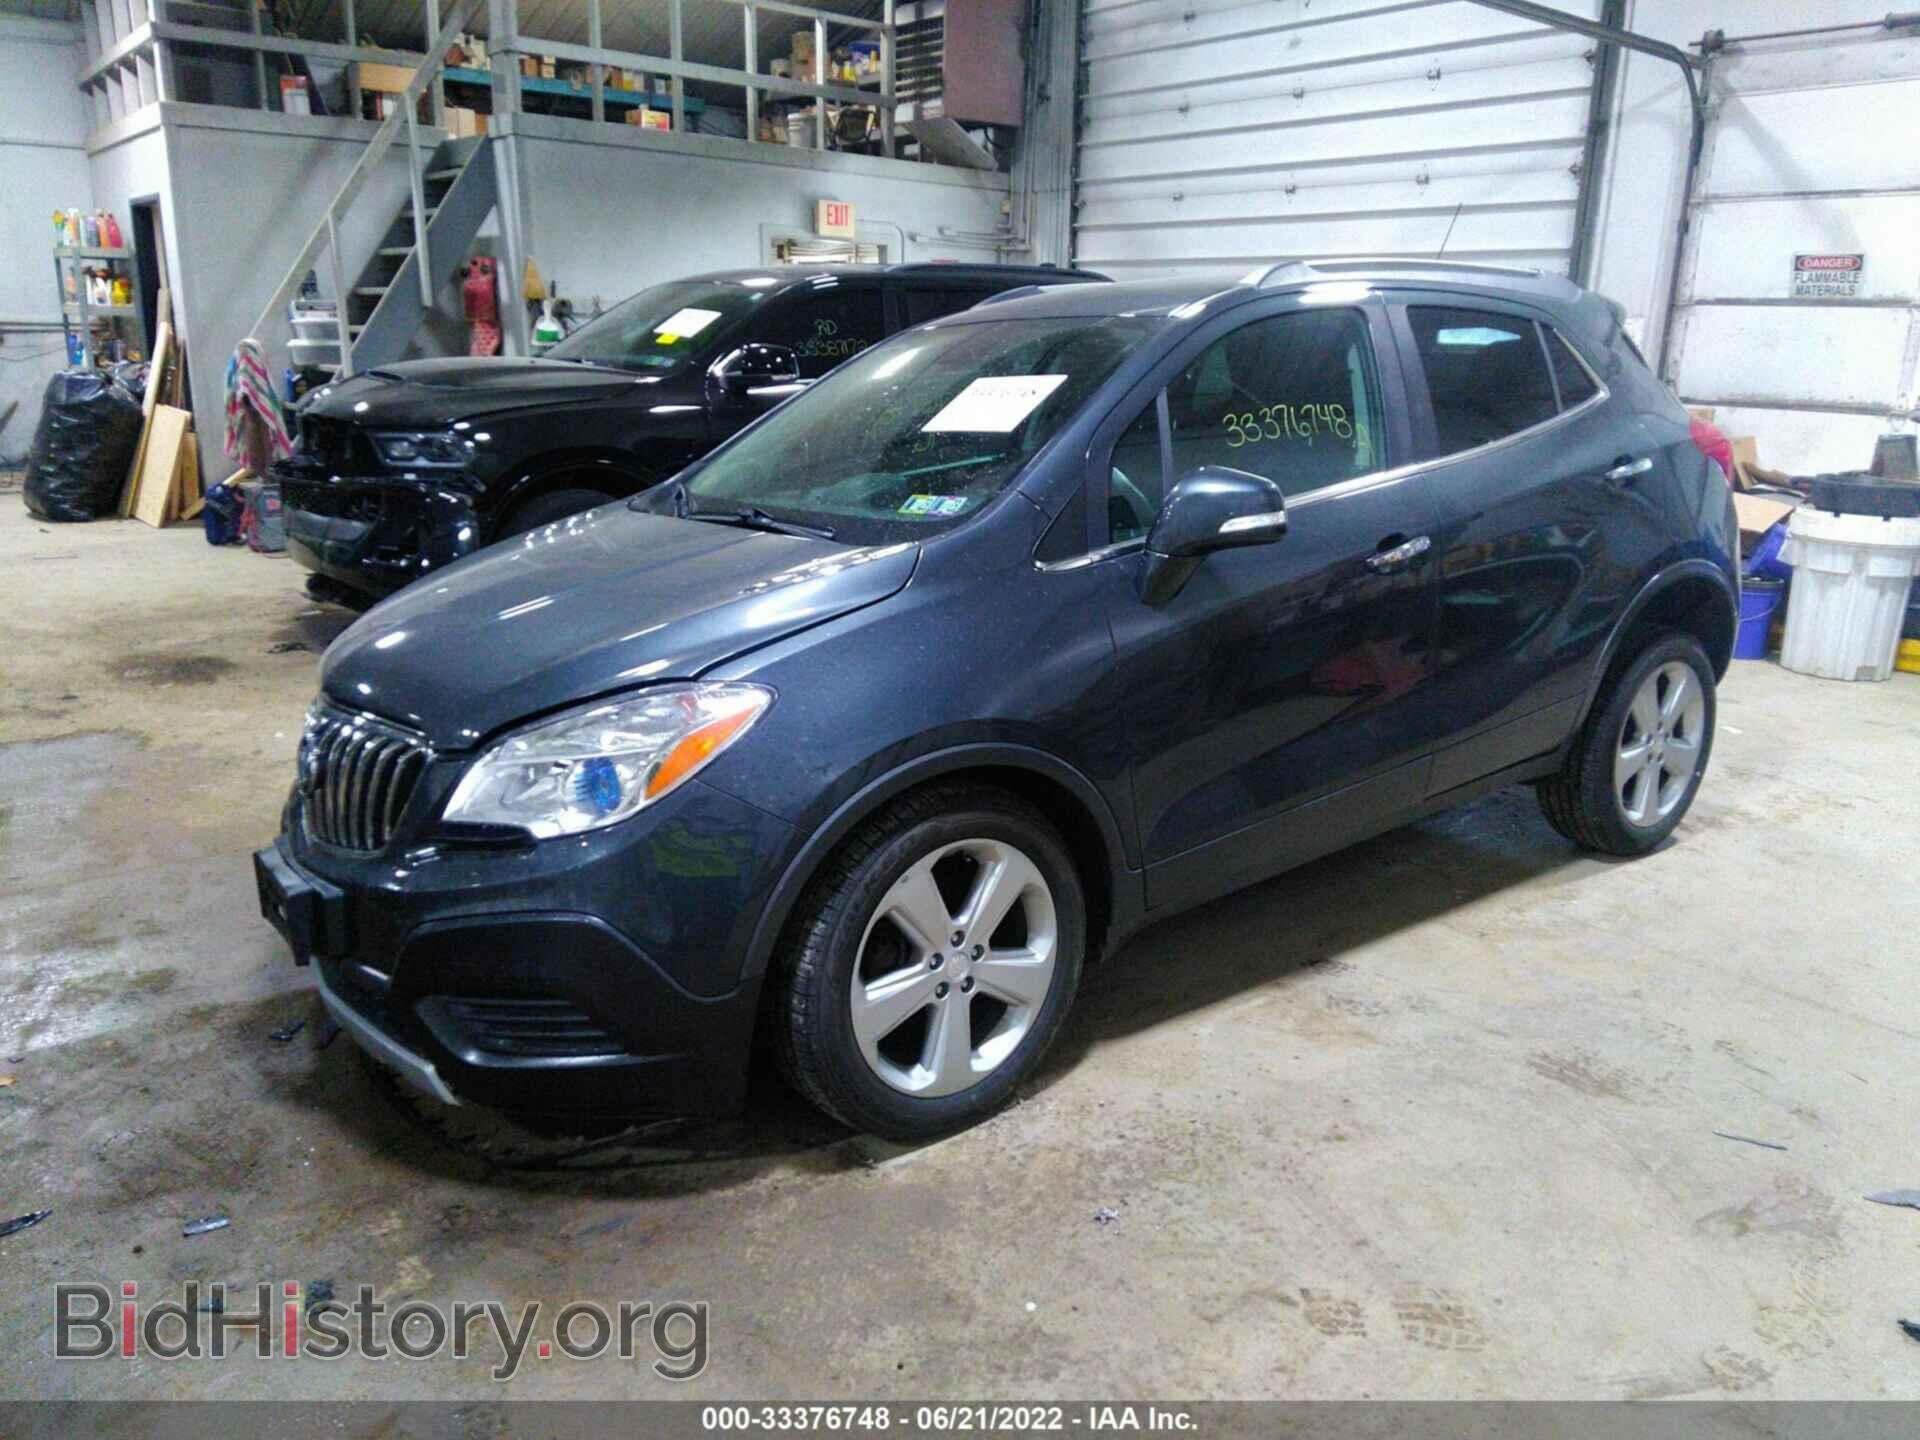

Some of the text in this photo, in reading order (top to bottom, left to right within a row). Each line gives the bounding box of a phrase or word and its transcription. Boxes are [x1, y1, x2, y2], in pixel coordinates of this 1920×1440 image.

[826, 203, 849, 226] EXIT
[1803, 256, 1853, 268] DANGER
[1794, 272, 1860, 284] FLAMMABLE
[1795, 284, 1856, 296] MATERIALS
[1222, 403, 1353, 448] 33376748
